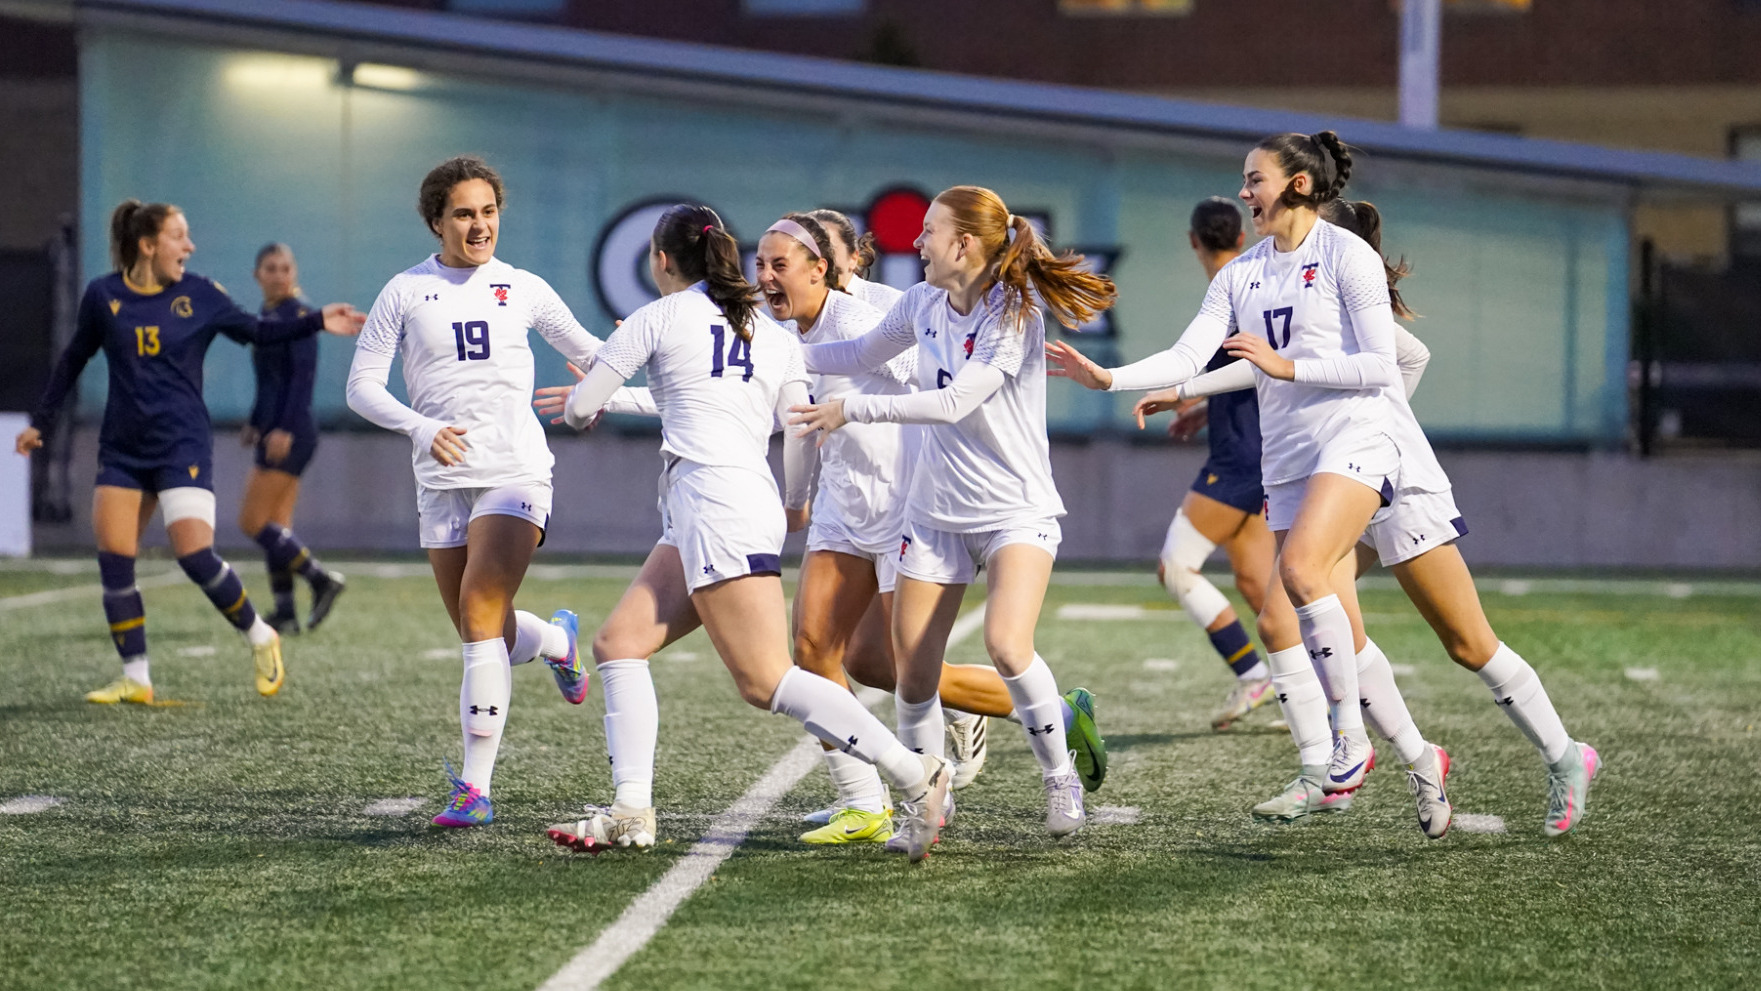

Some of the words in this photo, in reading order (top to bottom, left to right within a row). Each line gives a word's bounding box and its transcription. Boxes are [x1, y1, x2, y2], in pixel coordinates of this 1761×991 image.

[135, 325, 161, 356] 13
[452, 320, 490, 361] 19
[1263, 306, 1293, 350] 17
[710, 324, 754, 383] 14
